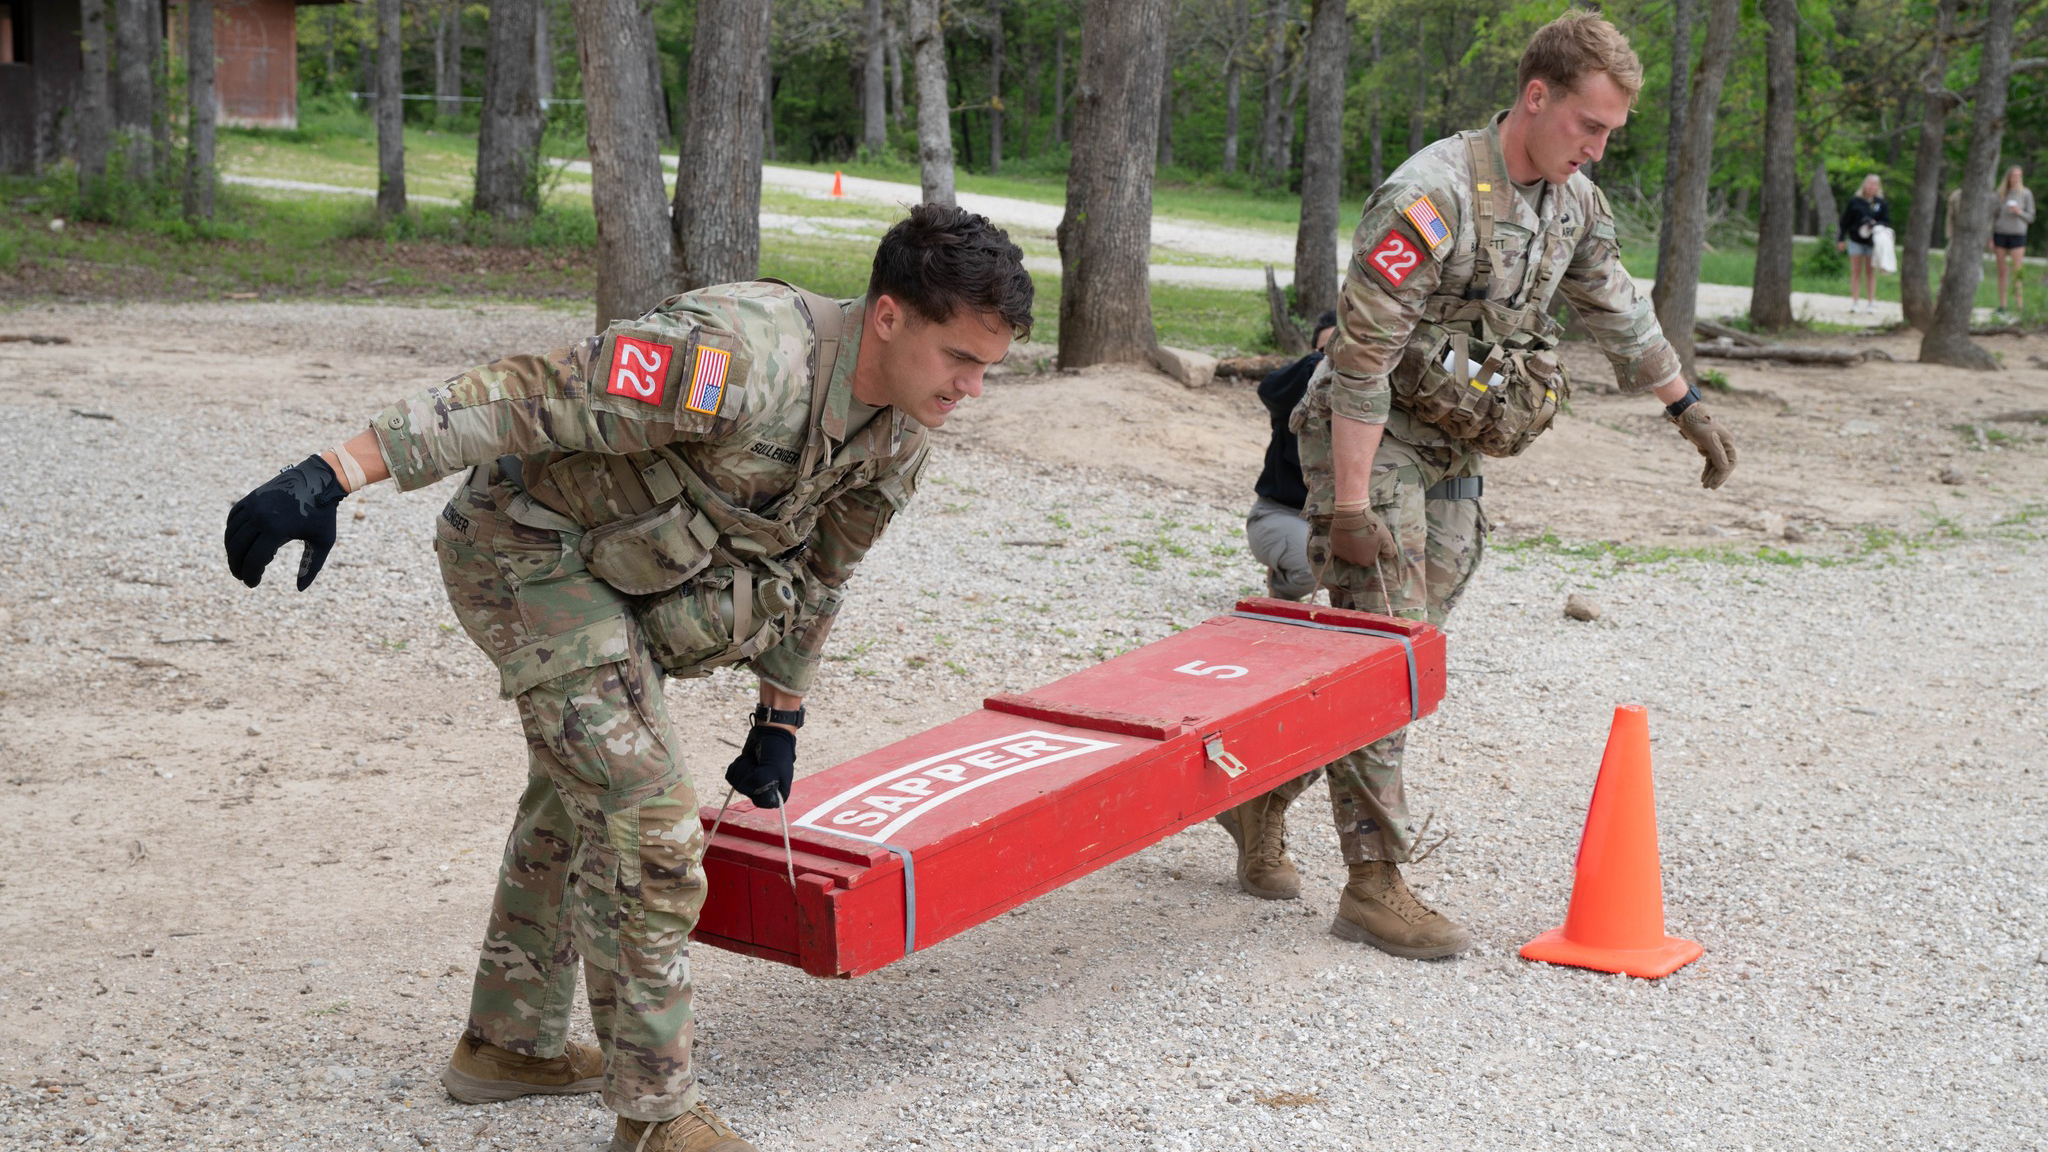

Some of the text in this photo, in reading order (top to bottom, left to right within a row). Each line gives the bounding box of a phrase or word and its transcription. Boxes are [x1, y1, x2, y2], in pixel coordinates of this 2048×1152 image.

[1562, 227, 1576, 237] ARY
[1375, 239, 1418, 280] 22
[616, 343, 662, 397] 22
[1172, 659, 1249, 679] 5
[832, 740, 1066, 827] SAPPER
